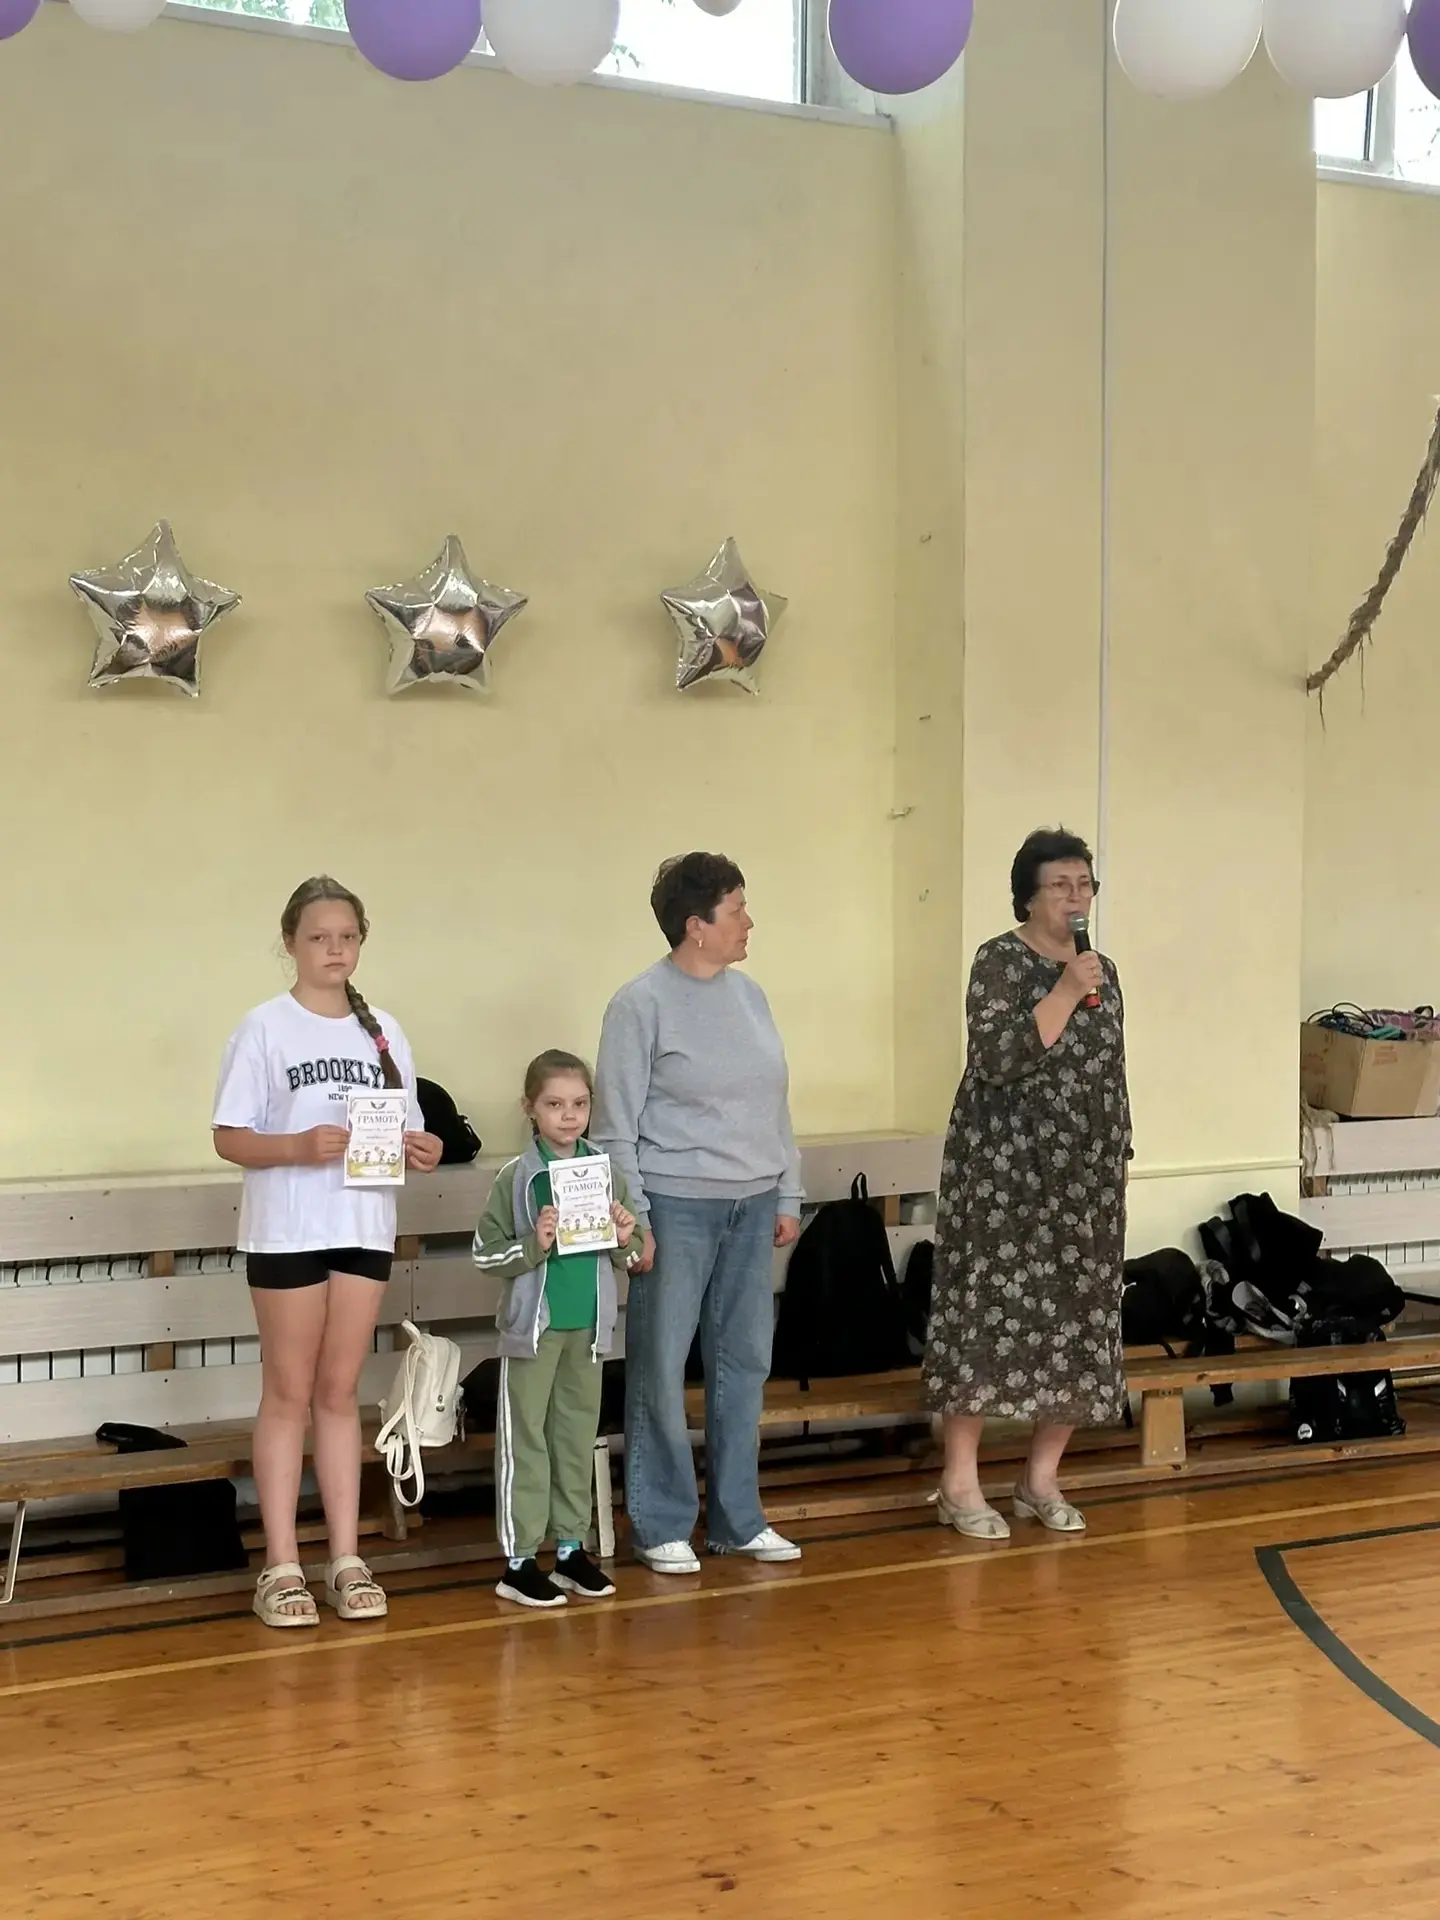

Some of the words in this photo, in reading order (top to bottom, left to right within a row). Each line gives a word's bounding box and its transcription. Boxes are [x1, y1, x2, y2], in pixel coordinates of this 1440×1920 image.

[286, 1057, 383, 1092] BROOKLY
[357, 1114, 399, 1124] ГРАМОТА
[563, 1181, 603, 1193] ГРАМОТА
